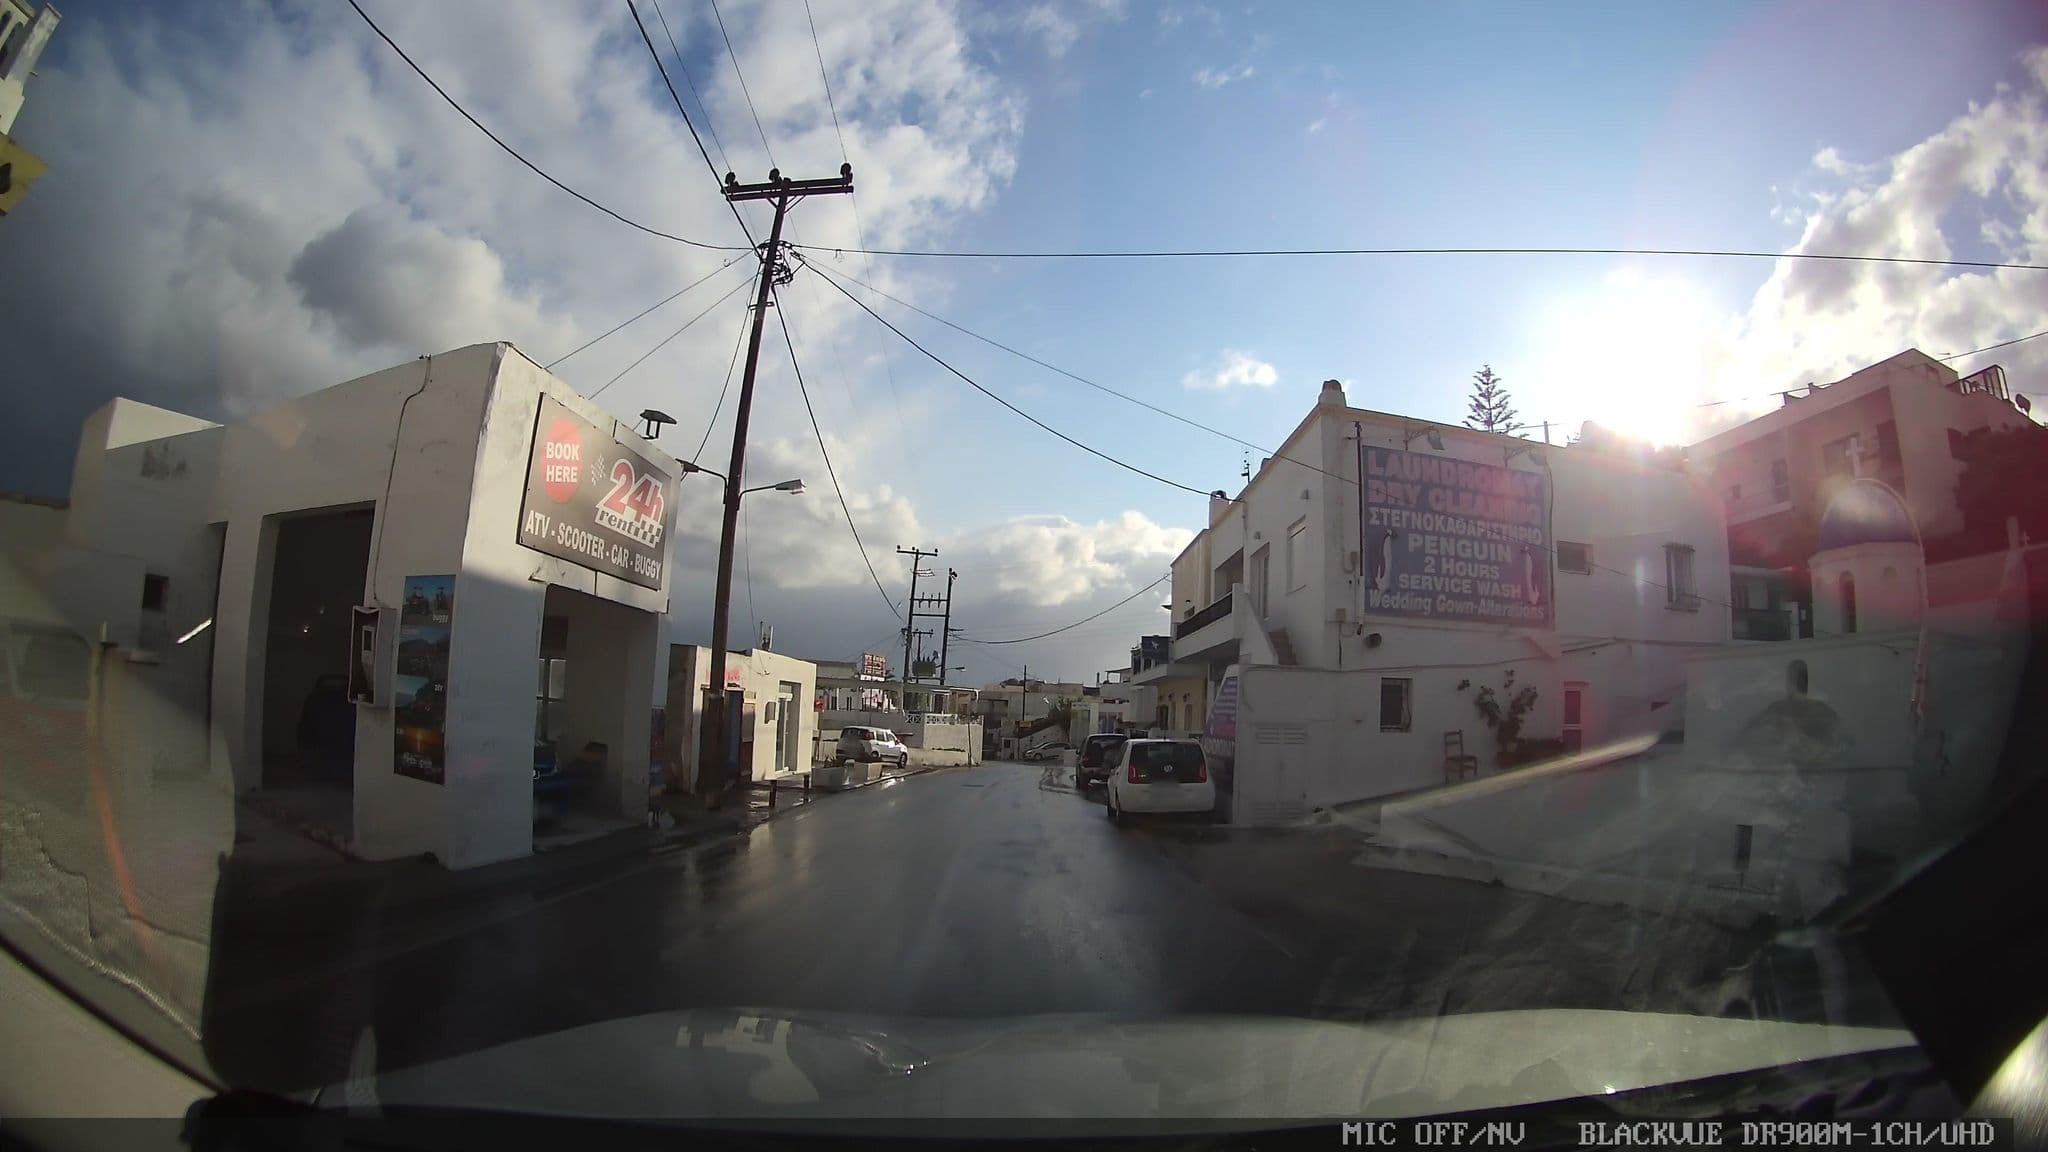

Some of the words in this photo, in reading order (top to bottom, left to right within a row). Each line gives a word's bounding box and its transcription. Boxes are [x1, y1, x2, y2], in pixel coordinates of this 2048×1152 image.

[545, 441, 580, 461] BOOK
[545, 464, 578, 483] HERE
[601, 459, 664, 524] 24h
[1367, 479, 1422, 509] DRY
[525, 510, 550, 539] ATV
[557, 522, 605, 560] SCOOTER
[611, 544, 630, 569] CAR
[634, 553, 662, 580] BUGGY
[1408, 533, 1512, 563] PENGUIN
[1423, 557, 1436, 574] 2
[1441, 558, 1501, 580] HOURS
[1398, 573, 1472, 594] SERVICE
[1477, 580, 1521, 599] WASH
[1369, 590, 1432, 616] Wedding
